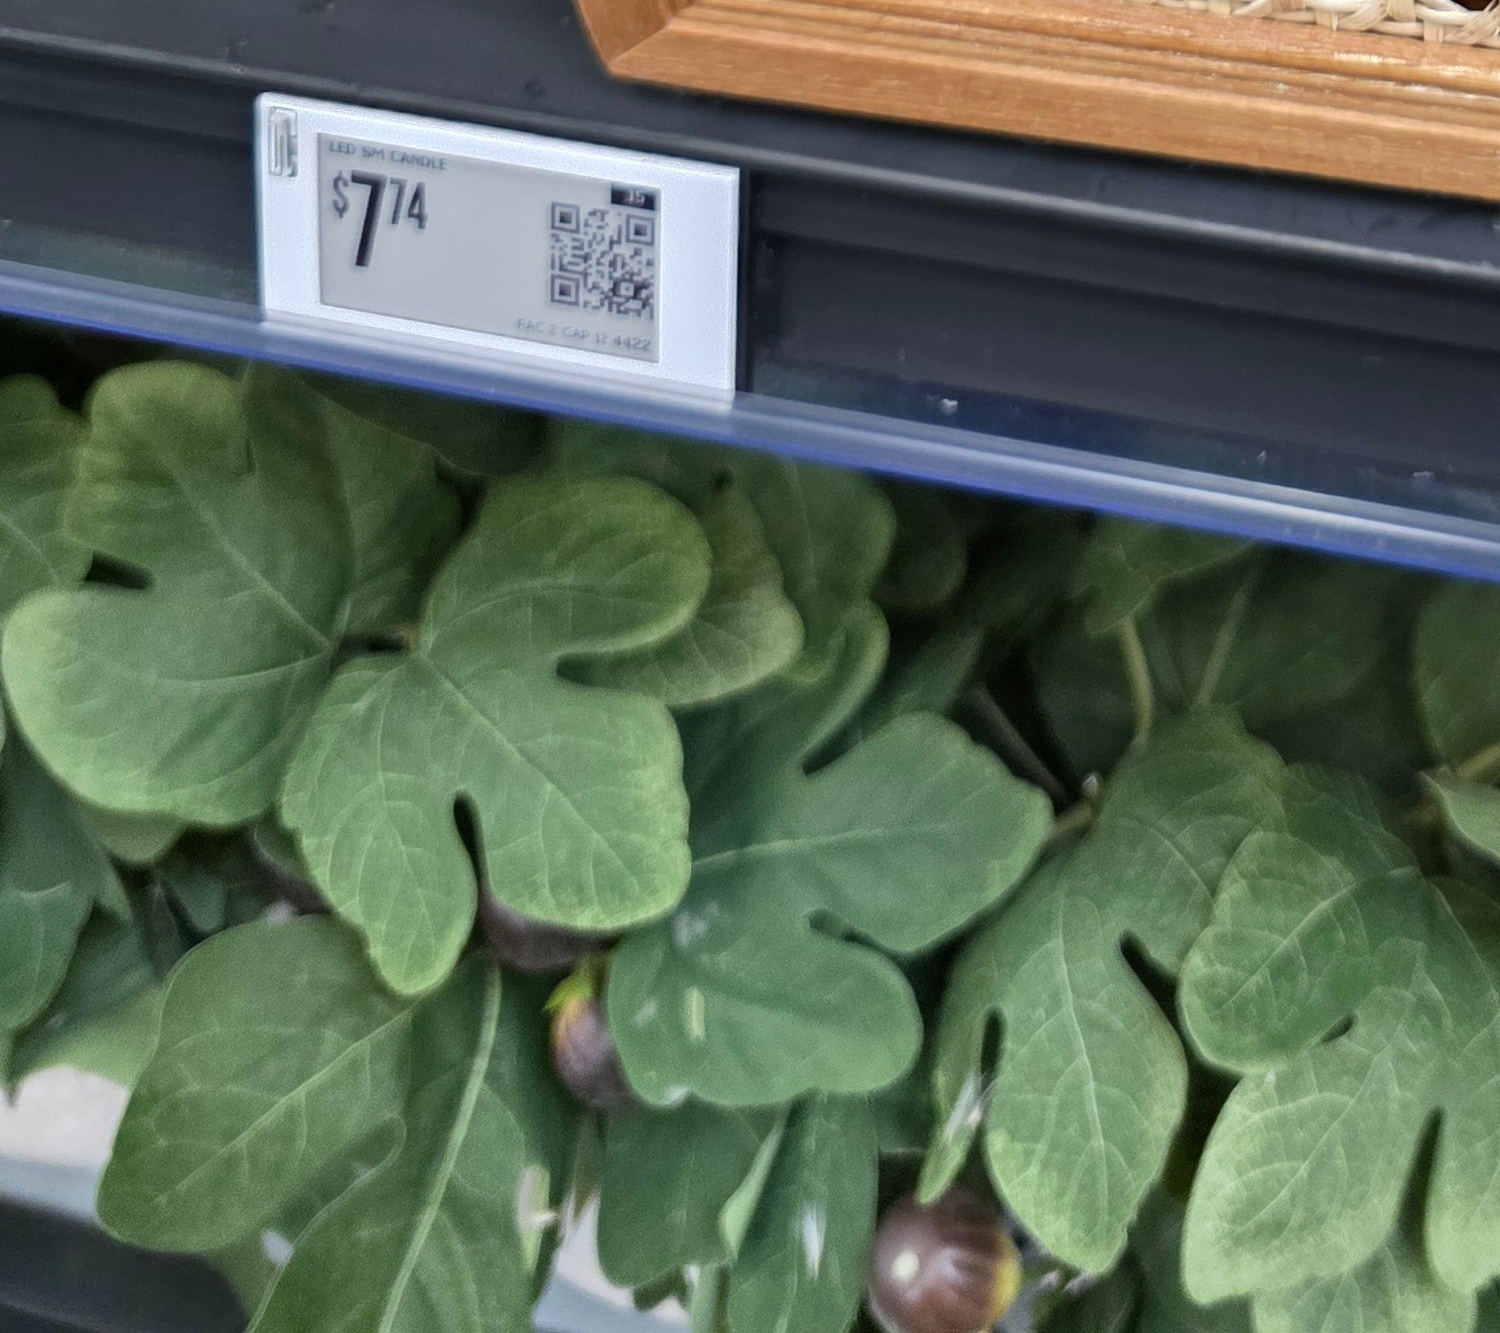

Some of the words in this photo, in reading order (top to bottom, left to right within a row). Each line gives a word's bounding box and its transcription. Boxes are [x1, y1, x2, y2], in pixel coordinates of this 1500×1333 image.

[329, 140, 356, 155] LED
[362, 145, 386, 161] SM
[390, 150, 448, 171] CANDLE
